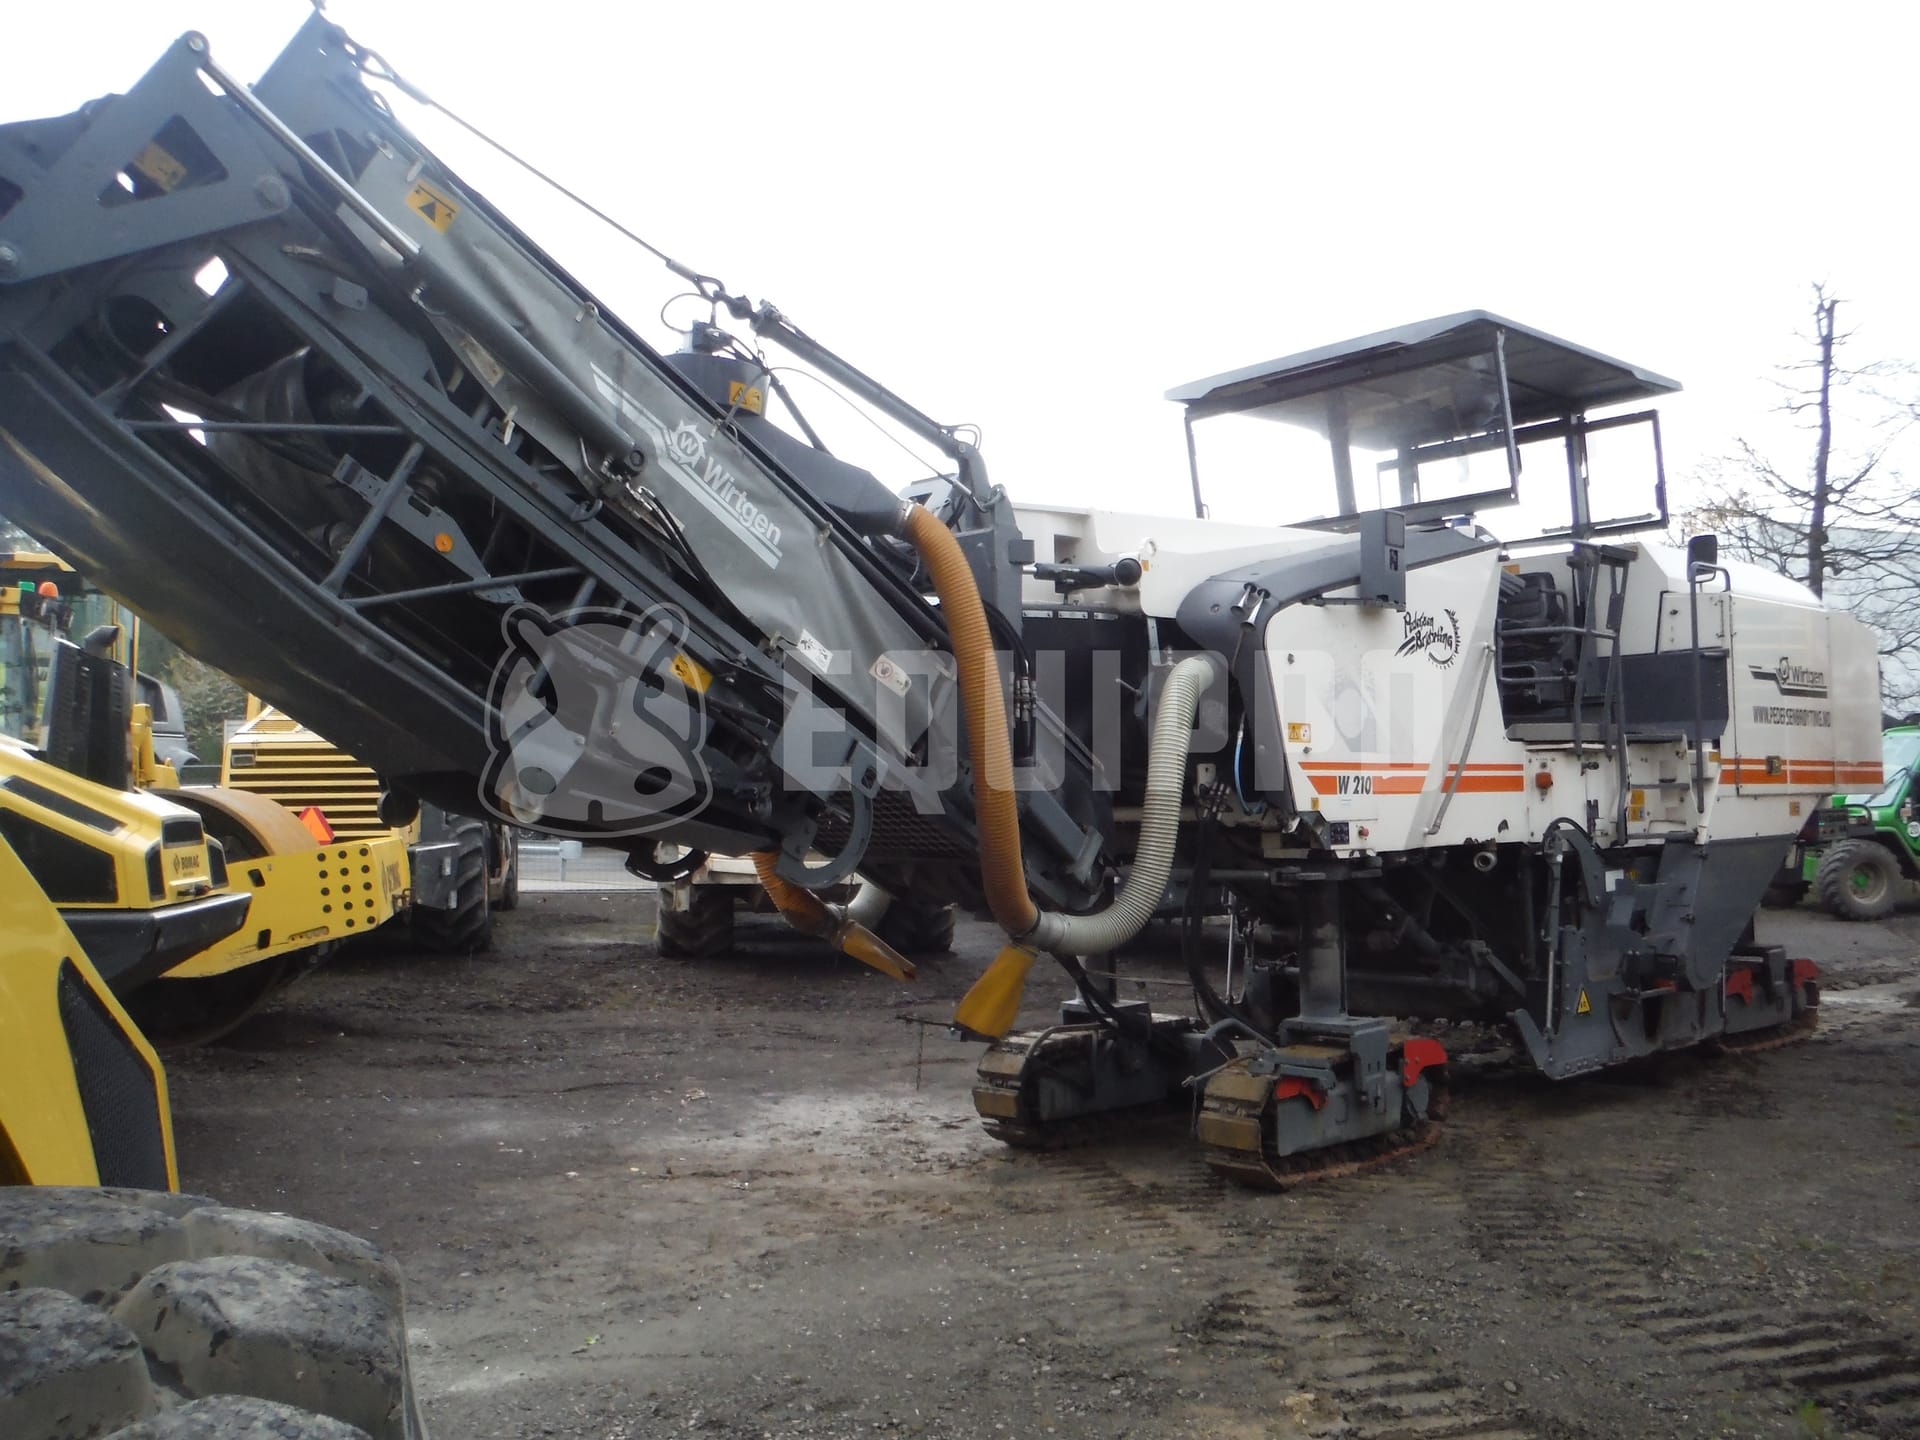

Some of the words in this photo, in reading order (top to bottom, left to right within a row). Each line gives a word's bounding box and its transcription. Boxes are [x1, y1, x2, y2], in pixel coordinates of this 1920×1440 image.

[703, 457, 782, 545] Wirtgen
[1791, 665, 1825, 685] Wirtgen
[1338, 775, 1350, 795] W
[1352, 775, 1372, 796] 210
